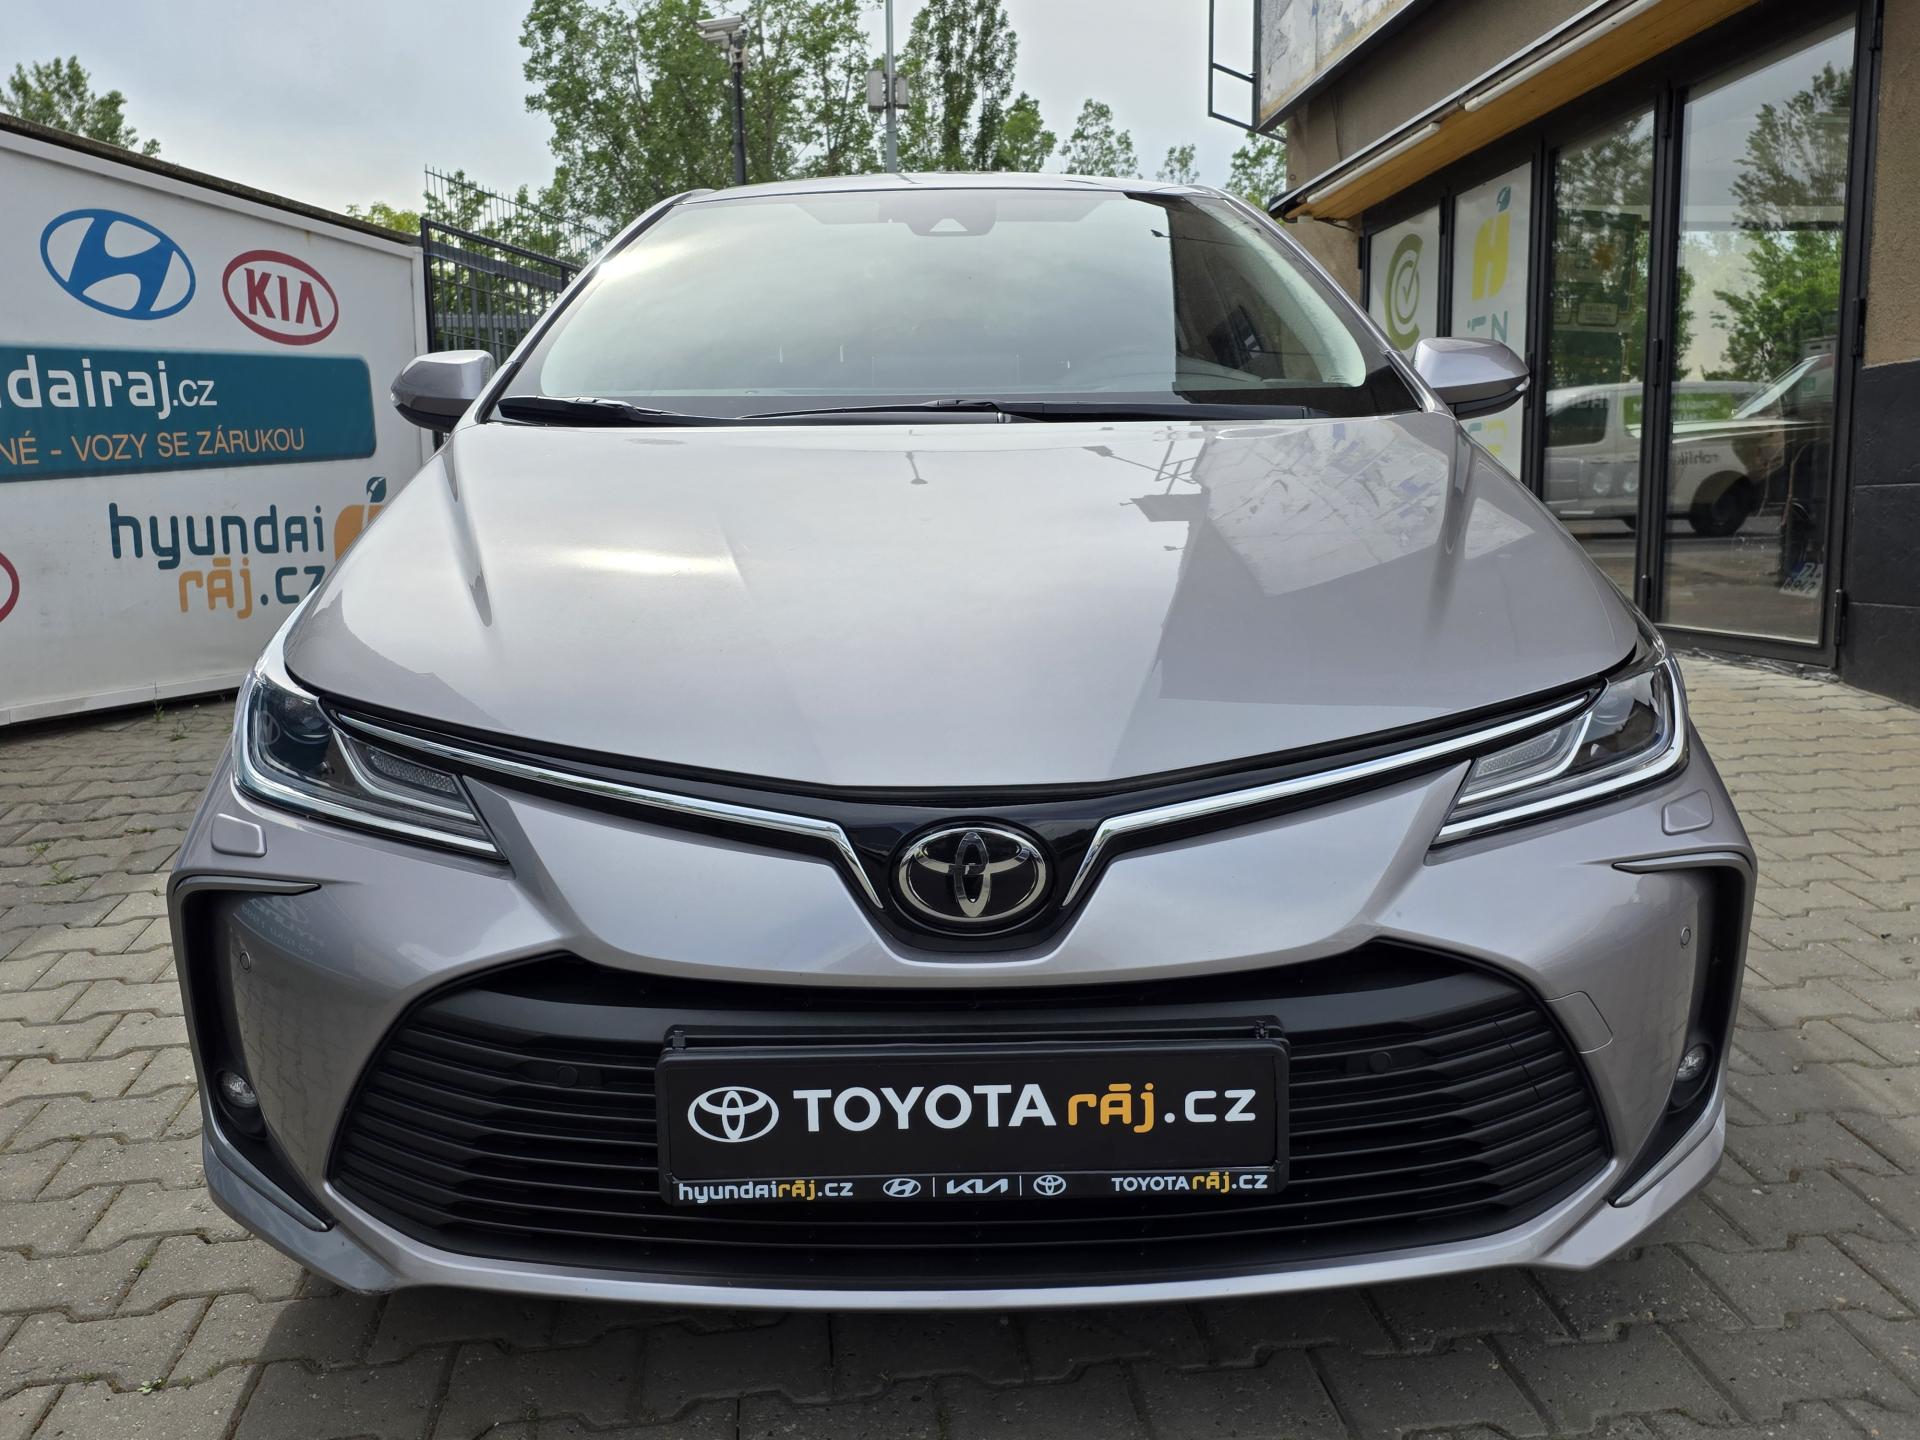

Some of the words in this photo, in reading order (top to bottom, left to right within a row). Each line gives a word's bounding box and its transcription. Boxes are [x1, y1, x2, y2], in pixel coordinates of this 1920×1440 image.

[243, 267, 323, 328] KIA
[0, 354, 218, 420] dairaj.cz
[71, 432, 147, 462] VOZY
[157, 431, 190, 457] SE
[196, 424, 305, 455] ZÁRUKOU
